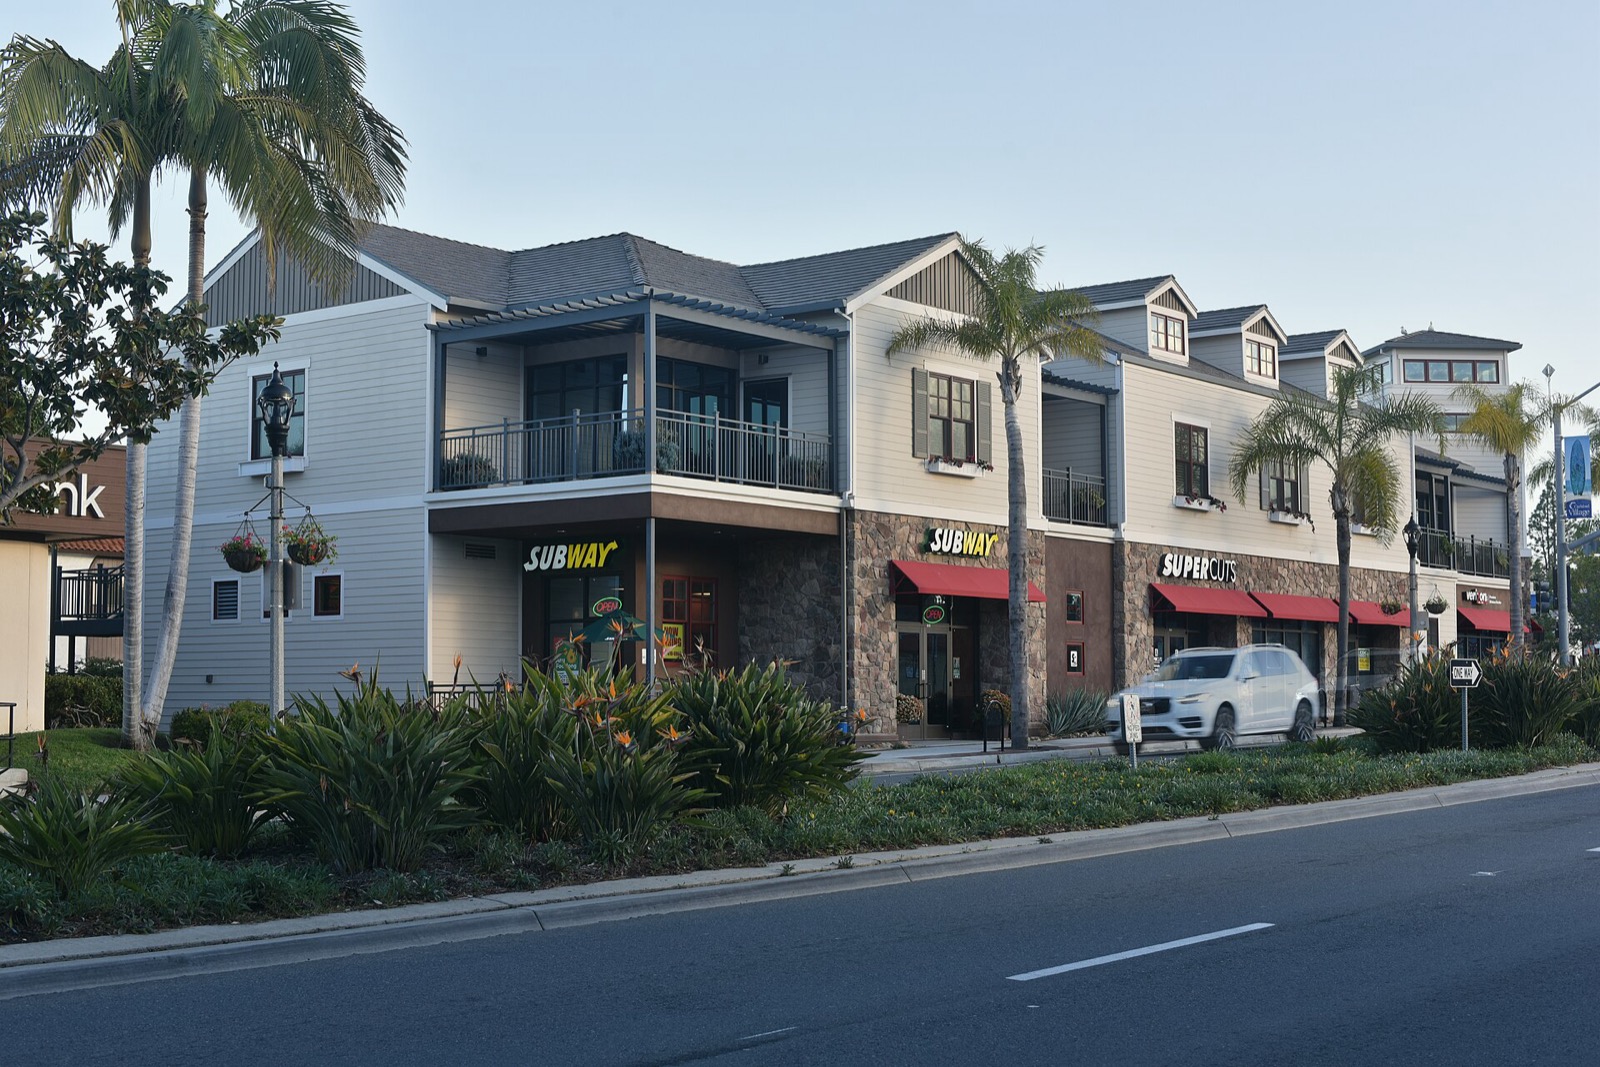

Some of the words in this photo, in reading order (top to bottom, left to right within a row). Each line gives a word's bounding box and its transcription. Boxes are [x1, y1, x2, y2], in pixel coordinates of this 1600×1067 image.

[930, 528, 998, 557] SUBWAY
[524, 540, 618, 572] SUBWAY
[1161, 553, 1237, 583] SUPERCUTS
[596, 601, 619, 612] OPEN
[926, 609, 942, 620] OPEN
[664, 626, 679, 636] NOW
[1453, 667, 1463, 678] ONE
[1464, 667, 1473, 678] WAY
